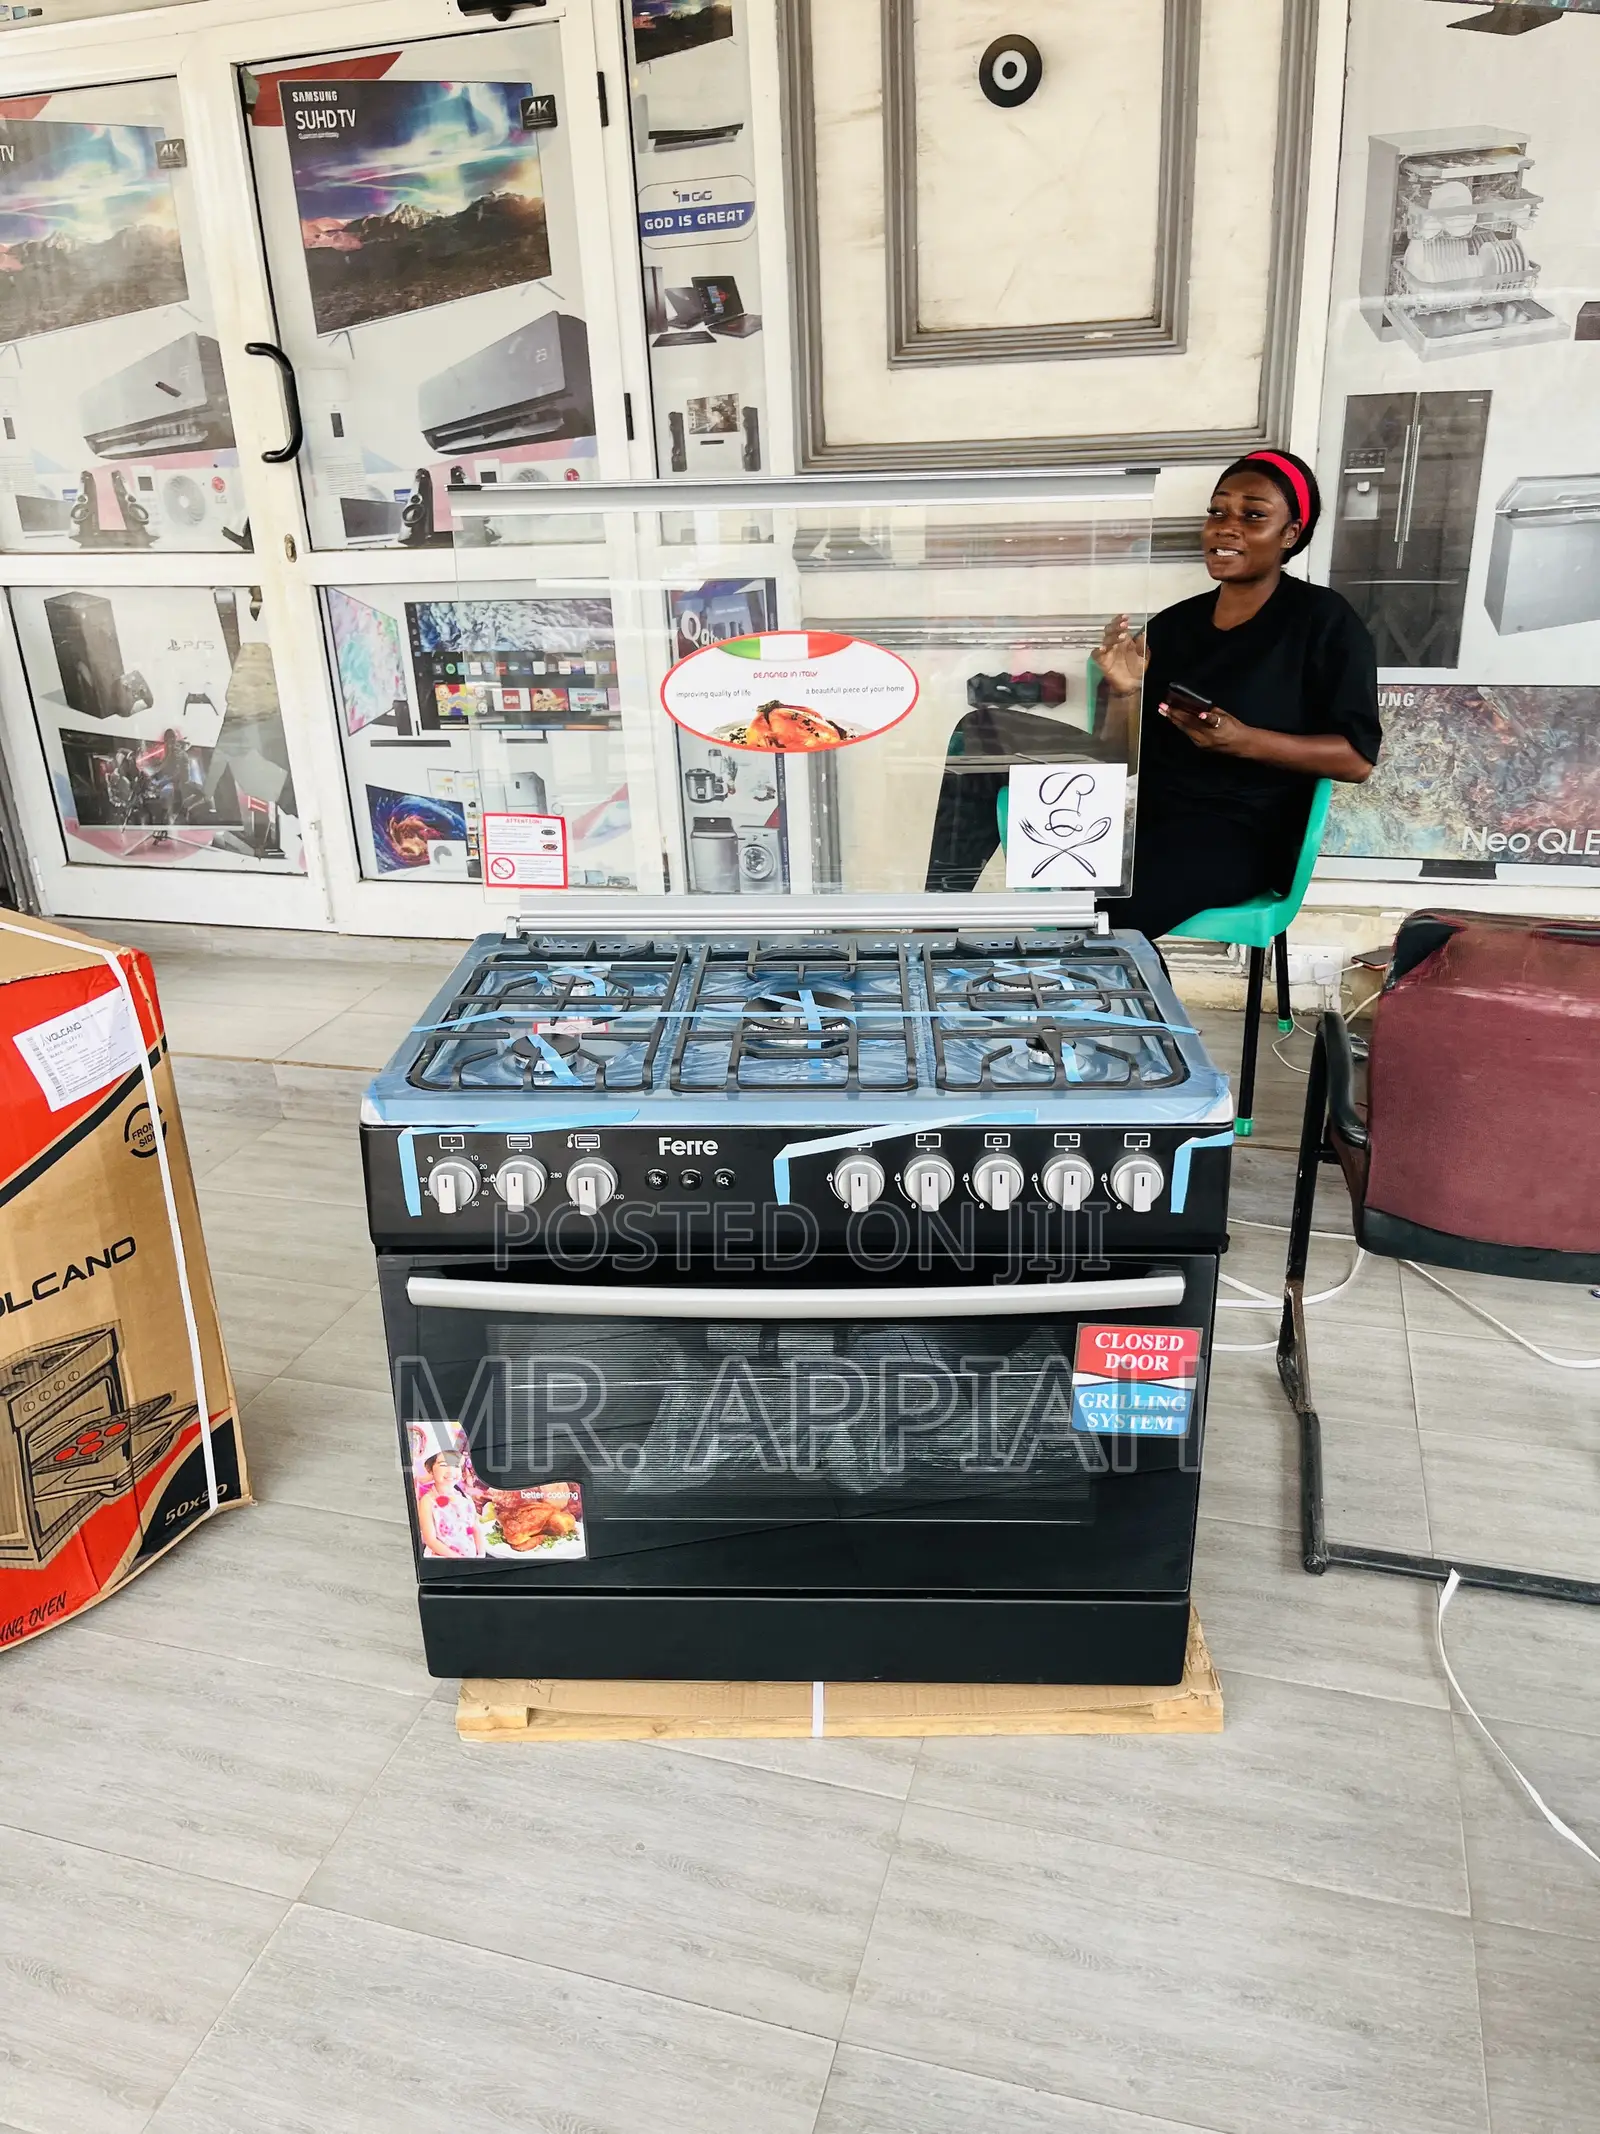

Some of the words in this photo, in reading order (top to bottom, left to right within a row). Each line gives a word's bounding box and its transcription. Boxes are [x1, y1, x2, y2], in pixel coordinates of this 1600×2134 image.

[292, 91, 338, 102] SAMSUNG
[526, 100, 550, 116] 4K
[160, 143, 180, 157] 4K
[644, 218, 673, 230] GOD
[679, 215, 692, 227] IS
[697, 209, 745, 225] GREAT
[753, 671, 788, 679] DESIGNED
[676, 690, 709, 699] improving
[710, 690, 731, 698] quality
[843, 686, 860, 695] piece
[870, 686, 885, 694] your
[1462, 826, 1531, 853] Neo
[1537, 828, 1600, 855] QLE
[45, 1021, 82, 1043] VOLCANO
[658, 1136, 719, 1156] Ferre
[0, 1236, 136, 1317] LCANO
[1094, 1332, 1184, 1351] CLOSED
[1104, 1352, 1169, 1371] DOOR
[1078, 1392, 1186, 1412] GRILLING
[1086, 1412, 1174, 1431] SYSTEM
[520, 1490, 544, 1499] better
[547, 1490, 579, 1501] cooking
[29, 1590, 67, 1627] OVEN
